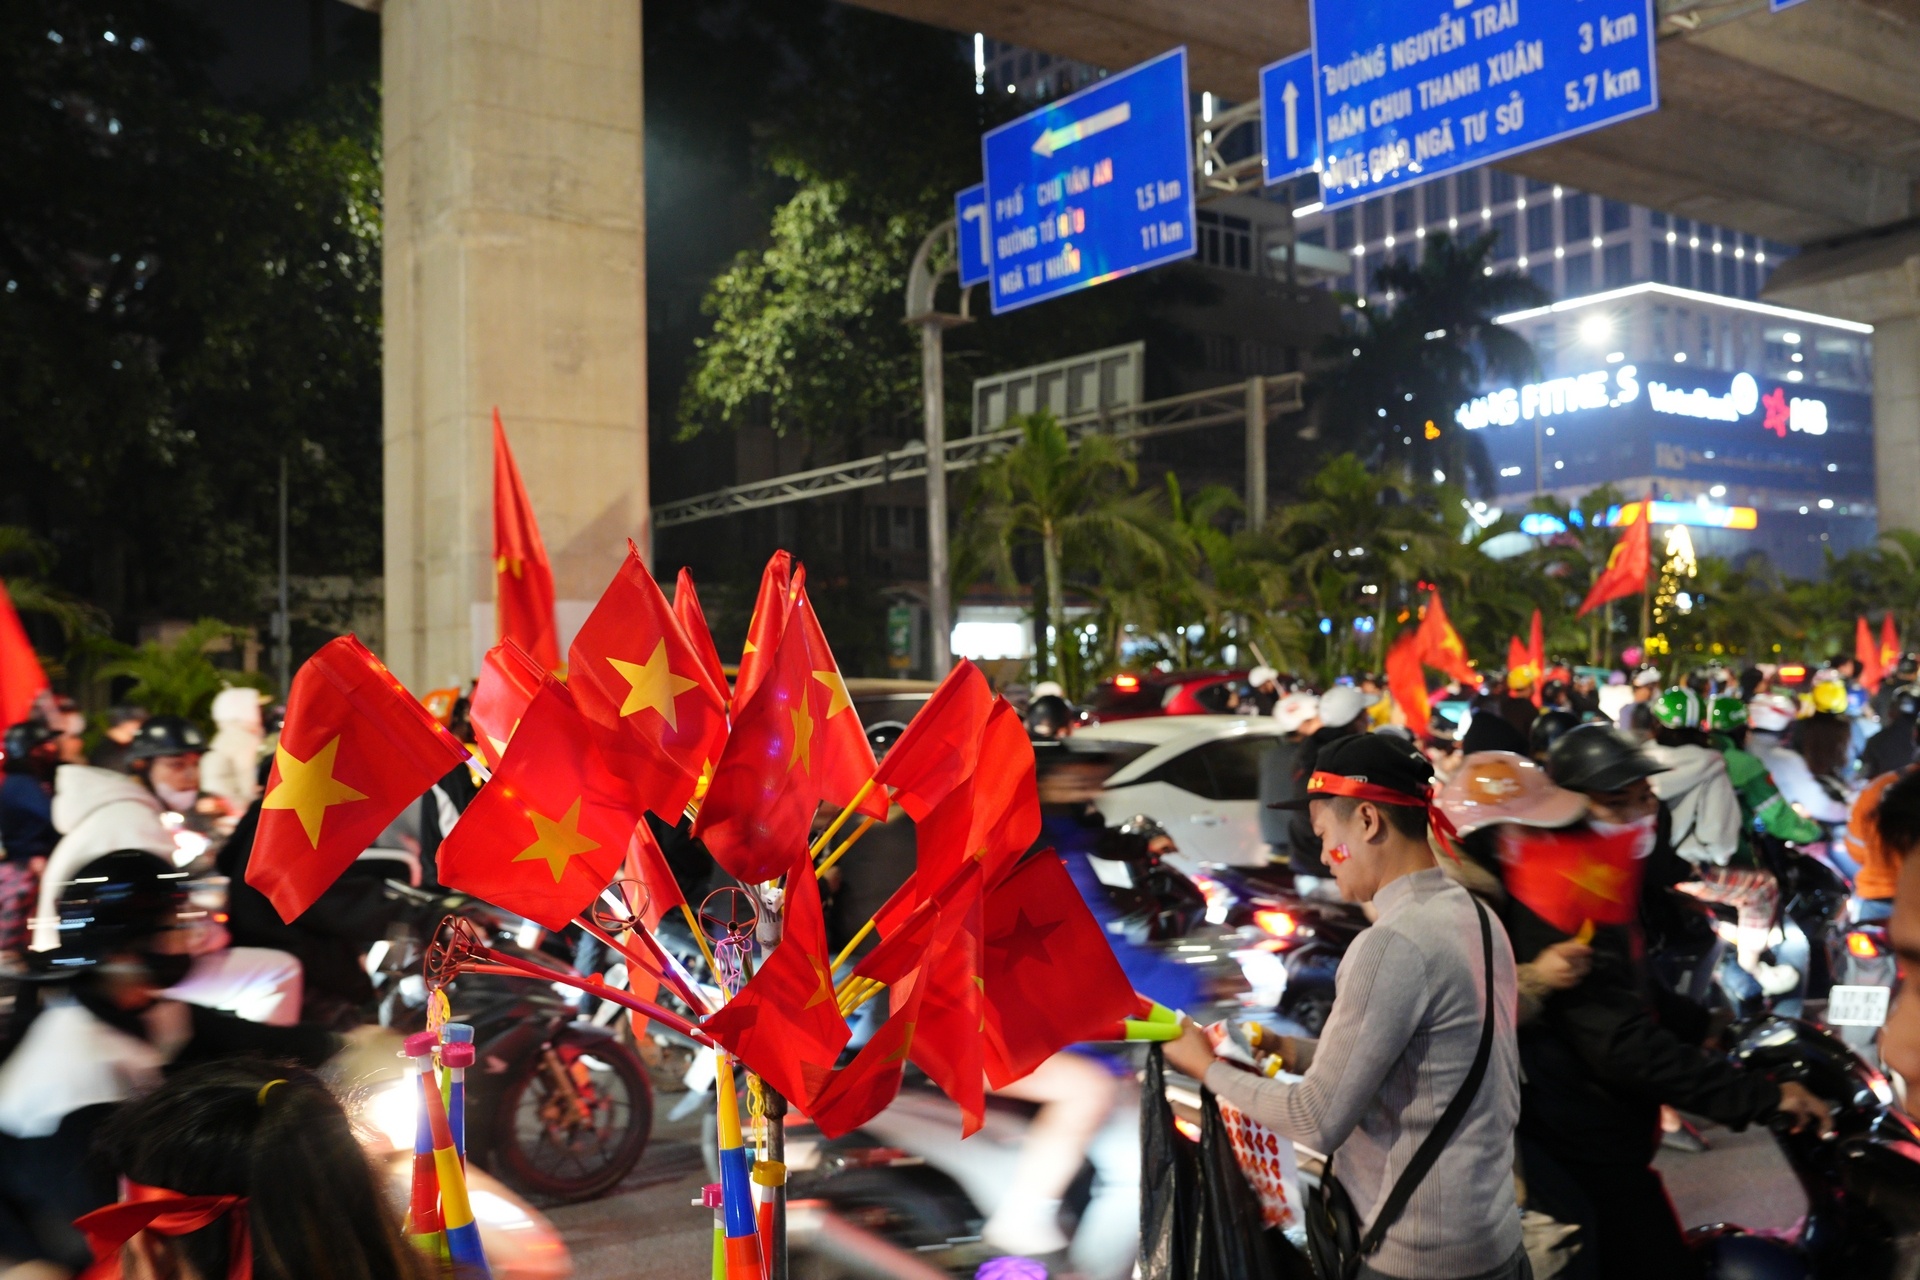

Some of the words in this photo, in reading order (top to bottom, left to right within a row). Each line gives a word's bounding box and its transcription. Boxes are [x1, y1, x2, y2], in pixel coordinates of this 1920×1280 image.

[1578, 22, 1594, 54] 3
[1600, 14, 1637, 47] km
[1325, 44, 1386, 95] ĐƯỜNG
[1391, 12, 1465, 71] NGUYỄN
[1369, 87, 1412, 127] CHUI
[1417, 62, 1480, 110] THANH
[1487, 39, 1544, 87] XUÂN
[1603, 67, 1640, 100] km
[1415, 117, 1455, 161] NGÃ
[1461, 109, 1489, 146] TƯ
[1495, 90, 1525, 135] SỞ
[1092, 157, 1113, 188] AN
[1157, 179, 1181, 204] km
[1140, 224, 1158, 251] 11
[1159, 220, 1183, 245] km
